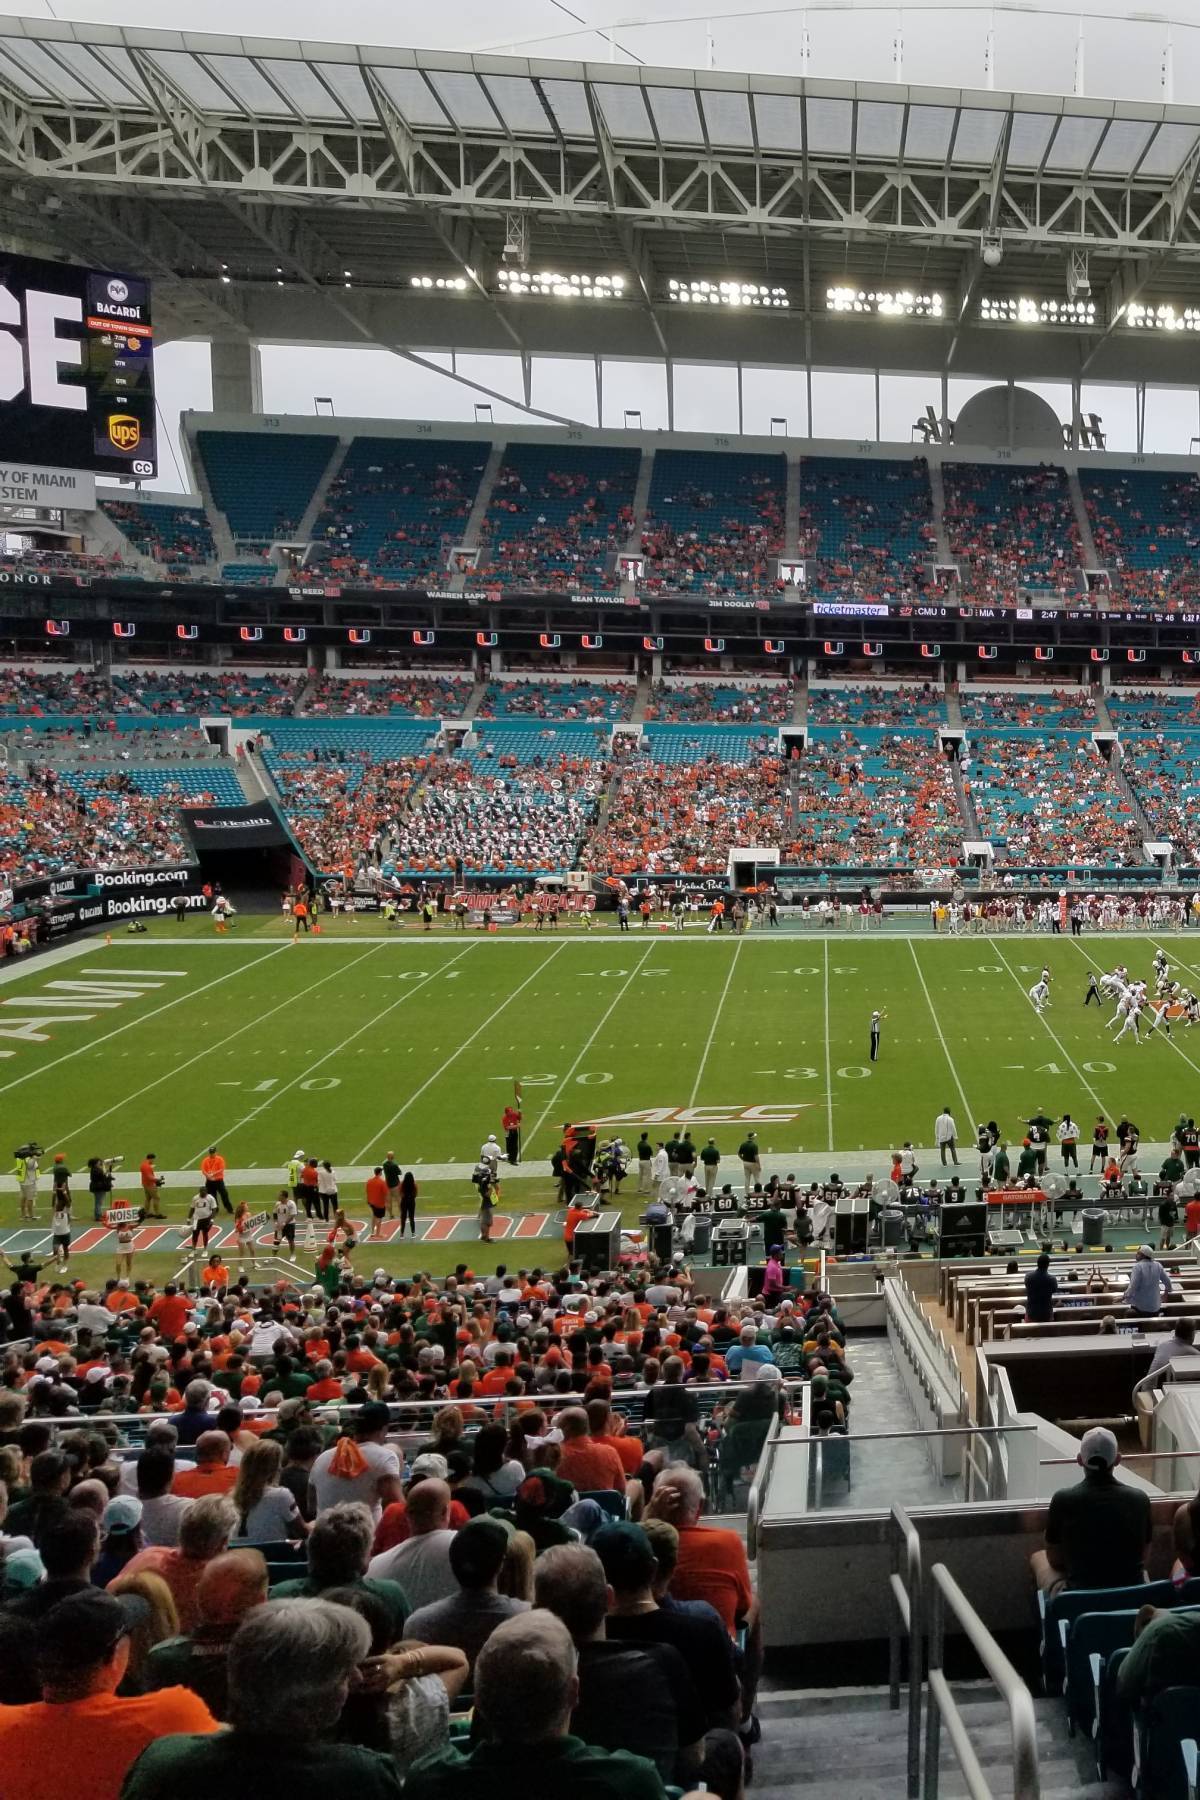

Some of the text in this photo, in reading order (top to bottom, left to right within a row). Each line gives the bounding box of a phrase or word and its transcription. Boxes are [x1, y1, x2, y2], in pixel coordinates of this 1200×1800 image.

[97, 302, 140, 319] BACARDÍ
[112, 422, 137, 445] ups
[134, 462, 151, 473] CC
[12, 472, 30, 484] OF
[32, 473, 76, 488] MIAMI
[465, 592, 486, 600] SAPP
[595, 596, 625, 604] TAYLOR
[816, 603, 882, 616] ticketmaster
[918, 607, 938, 616] CMU
[1041, 611, 1058, 619] 2:47
[95, 869, 188, 886] Booking.com
[783, 1067, 872, 1079] 30
[1034, 1062, 1118, 1074] 40
[242, 1077, 341, 1091] 10
[556, 1104, 813, 1126] ACC
[905, 1187, 920, 1197] 75
[718, 1198, 732, 1209] 60
[750, 1198, 764, 1208] 55
[109, 1209, 139, 1222] NOISE
[244, 1213, 267, 1228] NOISE
